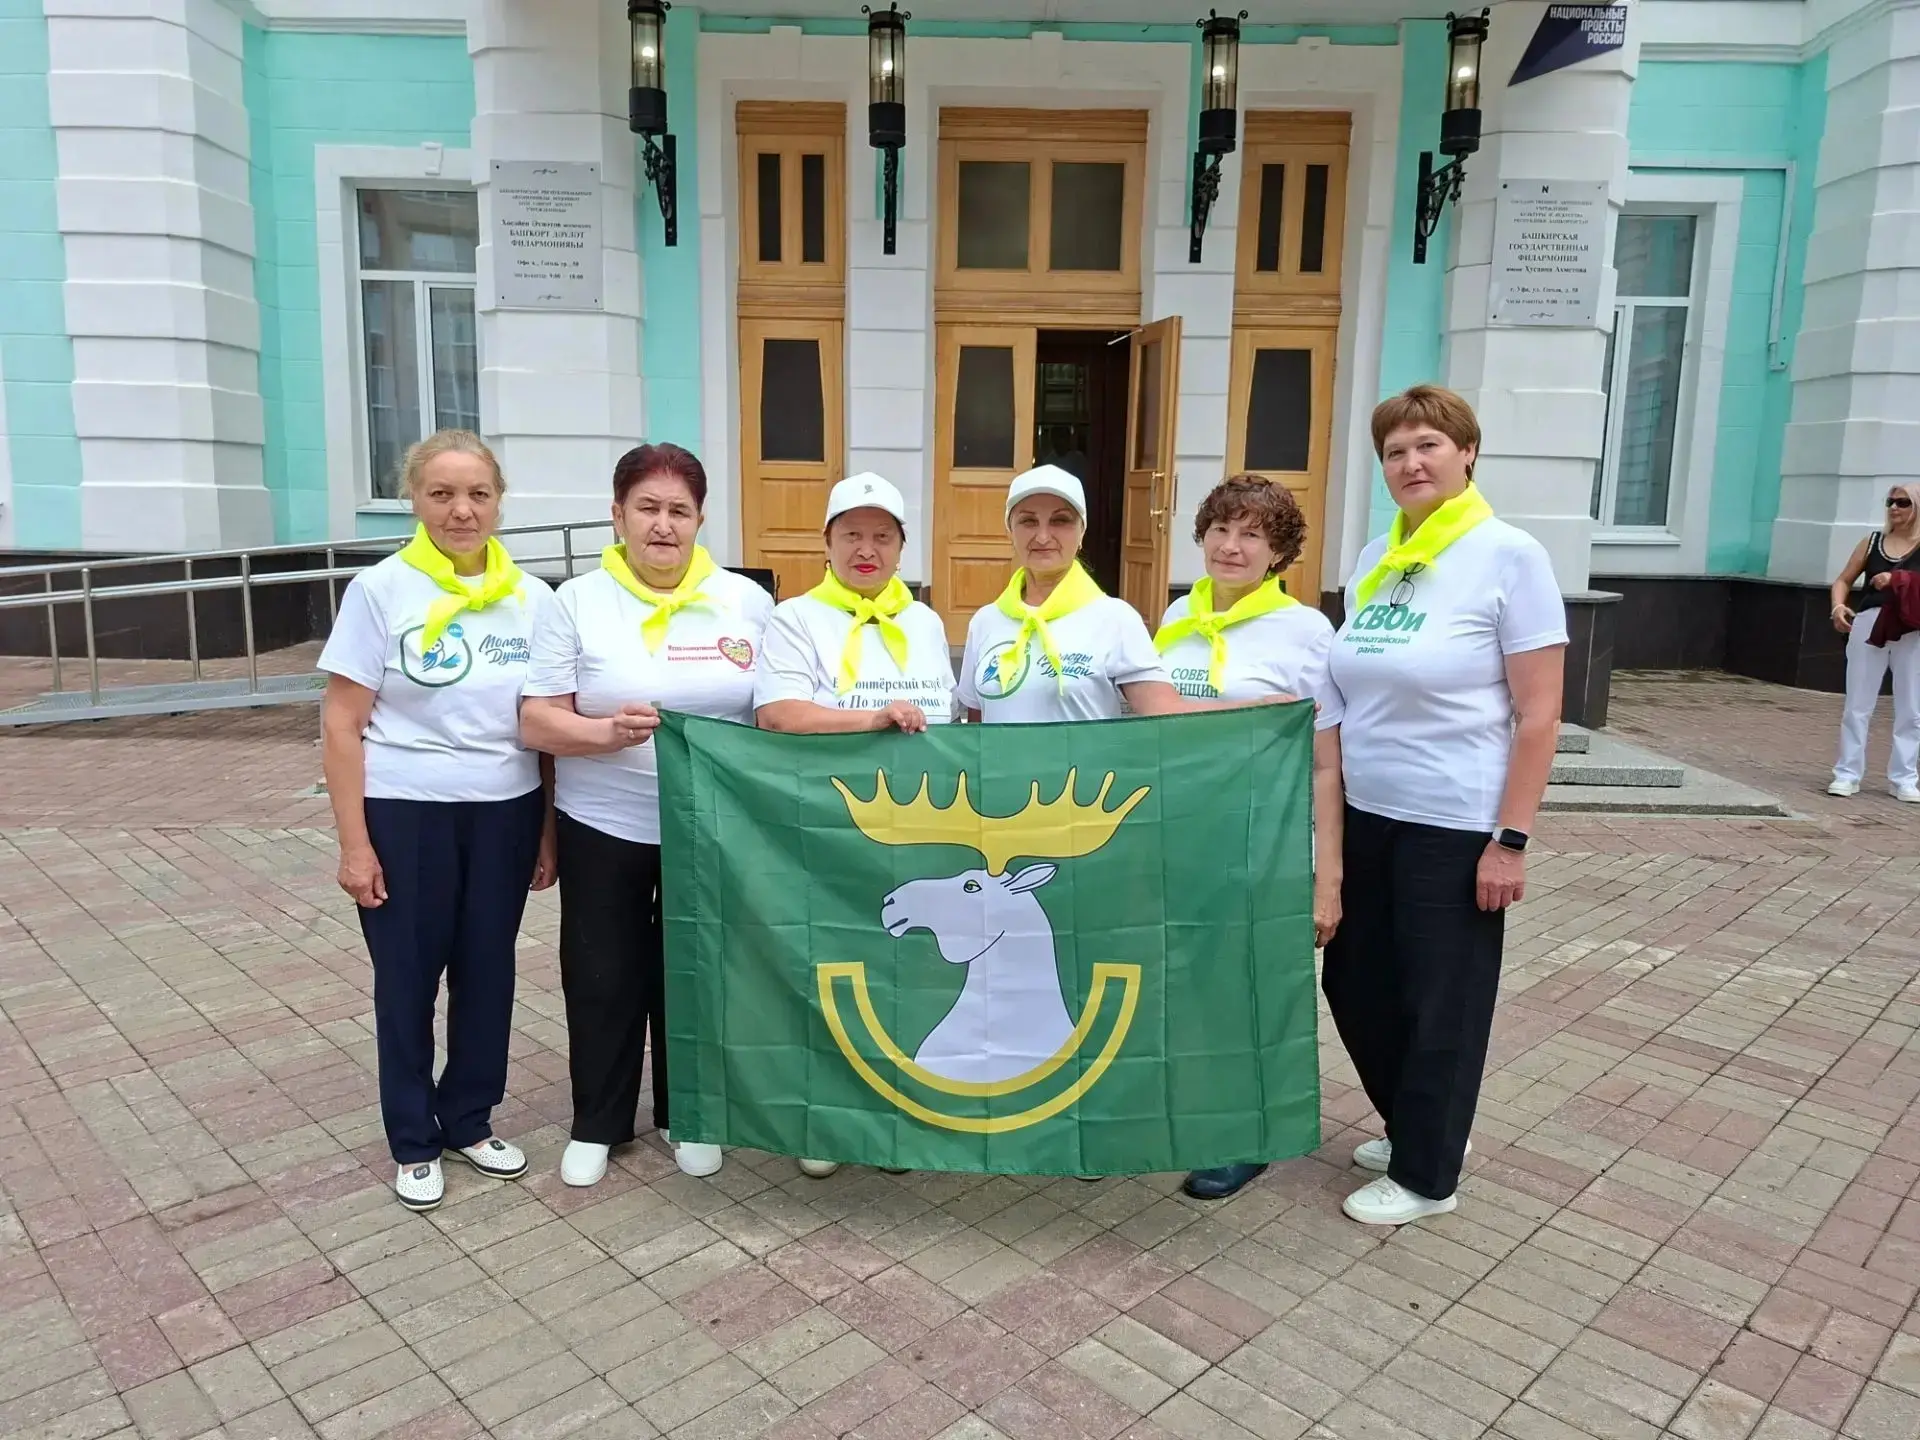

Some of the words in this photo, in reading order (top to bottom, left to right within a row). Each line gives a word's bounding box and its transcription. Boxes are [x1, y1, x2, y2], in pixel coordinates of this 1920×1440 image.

[1550, 6, 1626, 20] НАЦИОНАЛЬНЫЕ
[1580, 20, 1625, 33] ПРОЕКТЫ
[1587, 32, 1623, 45] РОССИИ
[1521, 232, 1579, 241] БАШКИРСКАЯ
[1508, 243, 1589, 252] ГОСУДАРСТВЕННАЯ
[1517, 254, 1578, 263] ФИЛАРМОНИЯ
[1356, 645, 1385, 656] район
